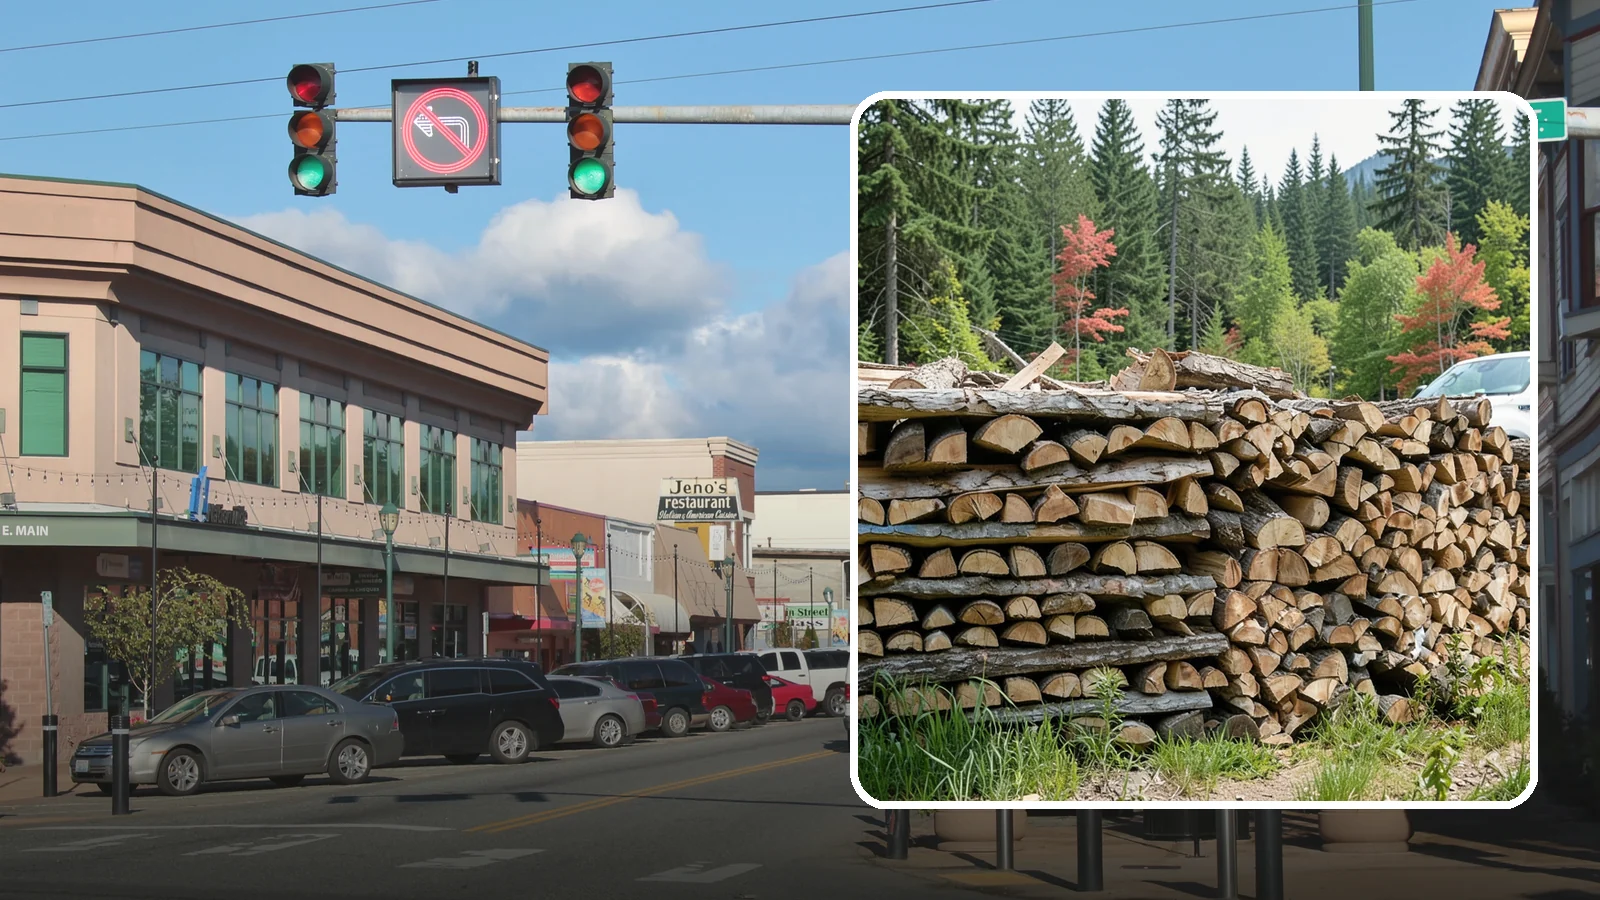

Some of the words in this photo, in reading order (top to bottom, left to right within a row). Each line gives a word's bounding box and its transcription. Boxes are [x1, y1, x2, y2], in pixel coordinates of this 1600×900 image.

[670, 480, 727, 494] Jeno's
[665, 496, 731, 509] restaurant
[659, 510, 682, 520] Italian
[686, 510, 714, 519] American
[715, 509, 737, 519] Cuisine
[2, 525, 13, 536] E.
[15, 525, 49, 536] MAIN
[797, 607, 828, 617] Street
[791, 619, 823, 627] lass
